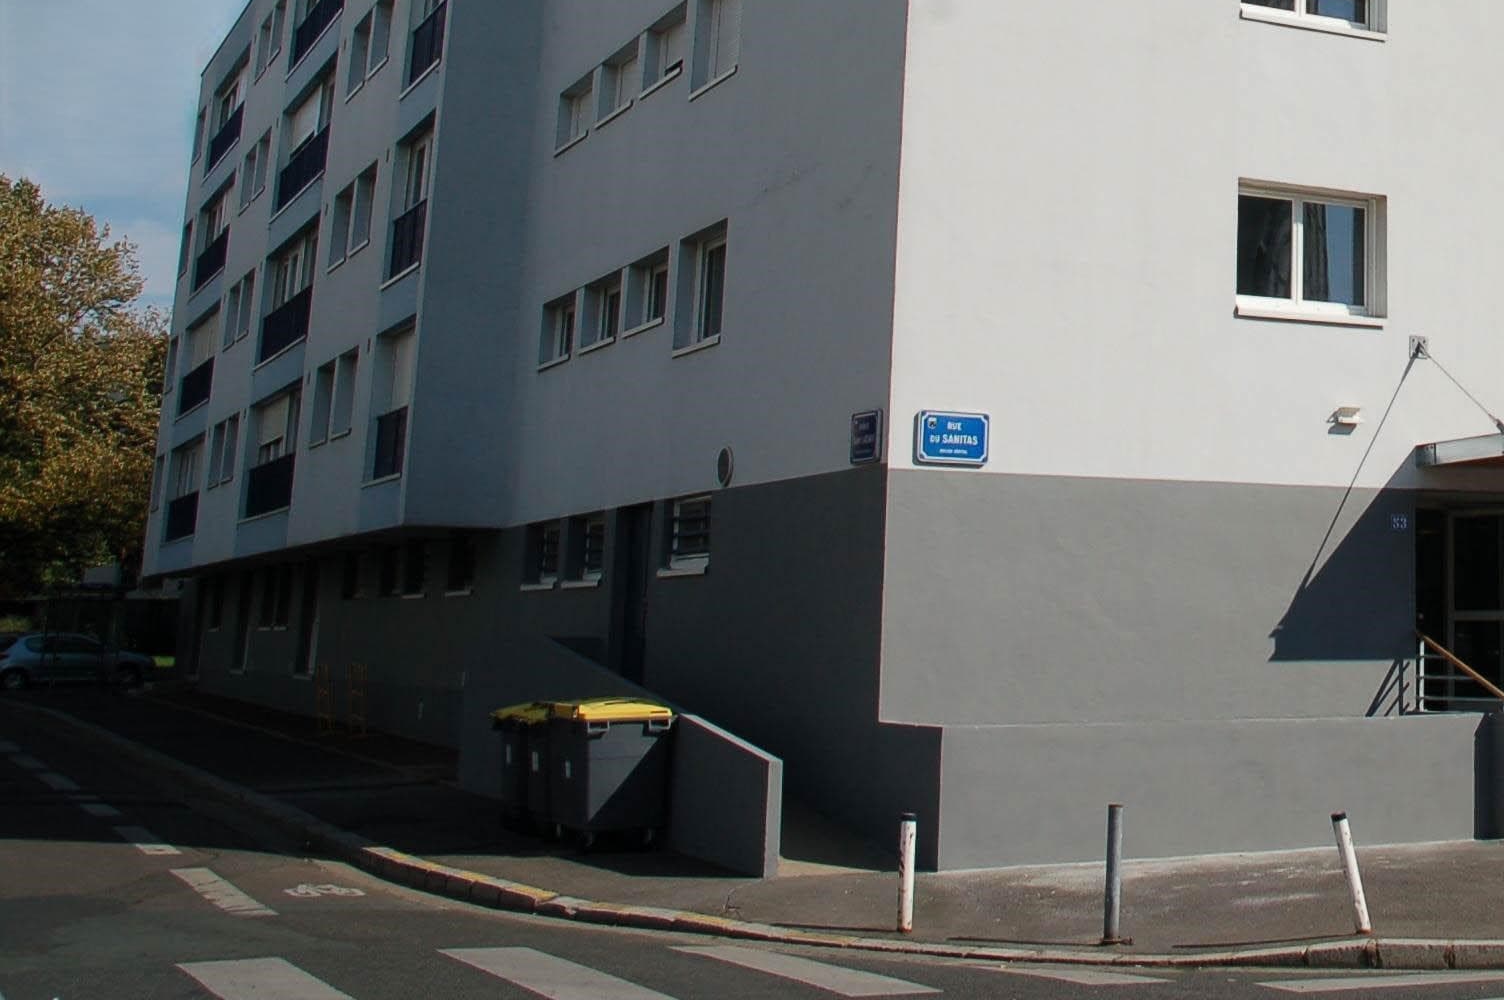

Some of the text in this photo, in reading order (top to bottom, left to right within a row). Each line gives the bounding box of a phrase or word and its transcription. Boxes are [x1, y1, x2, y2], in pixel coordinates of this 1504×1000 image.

[947, 421, 962, 431] RUE
[930, 433, 978, 446] DU SANITAS
